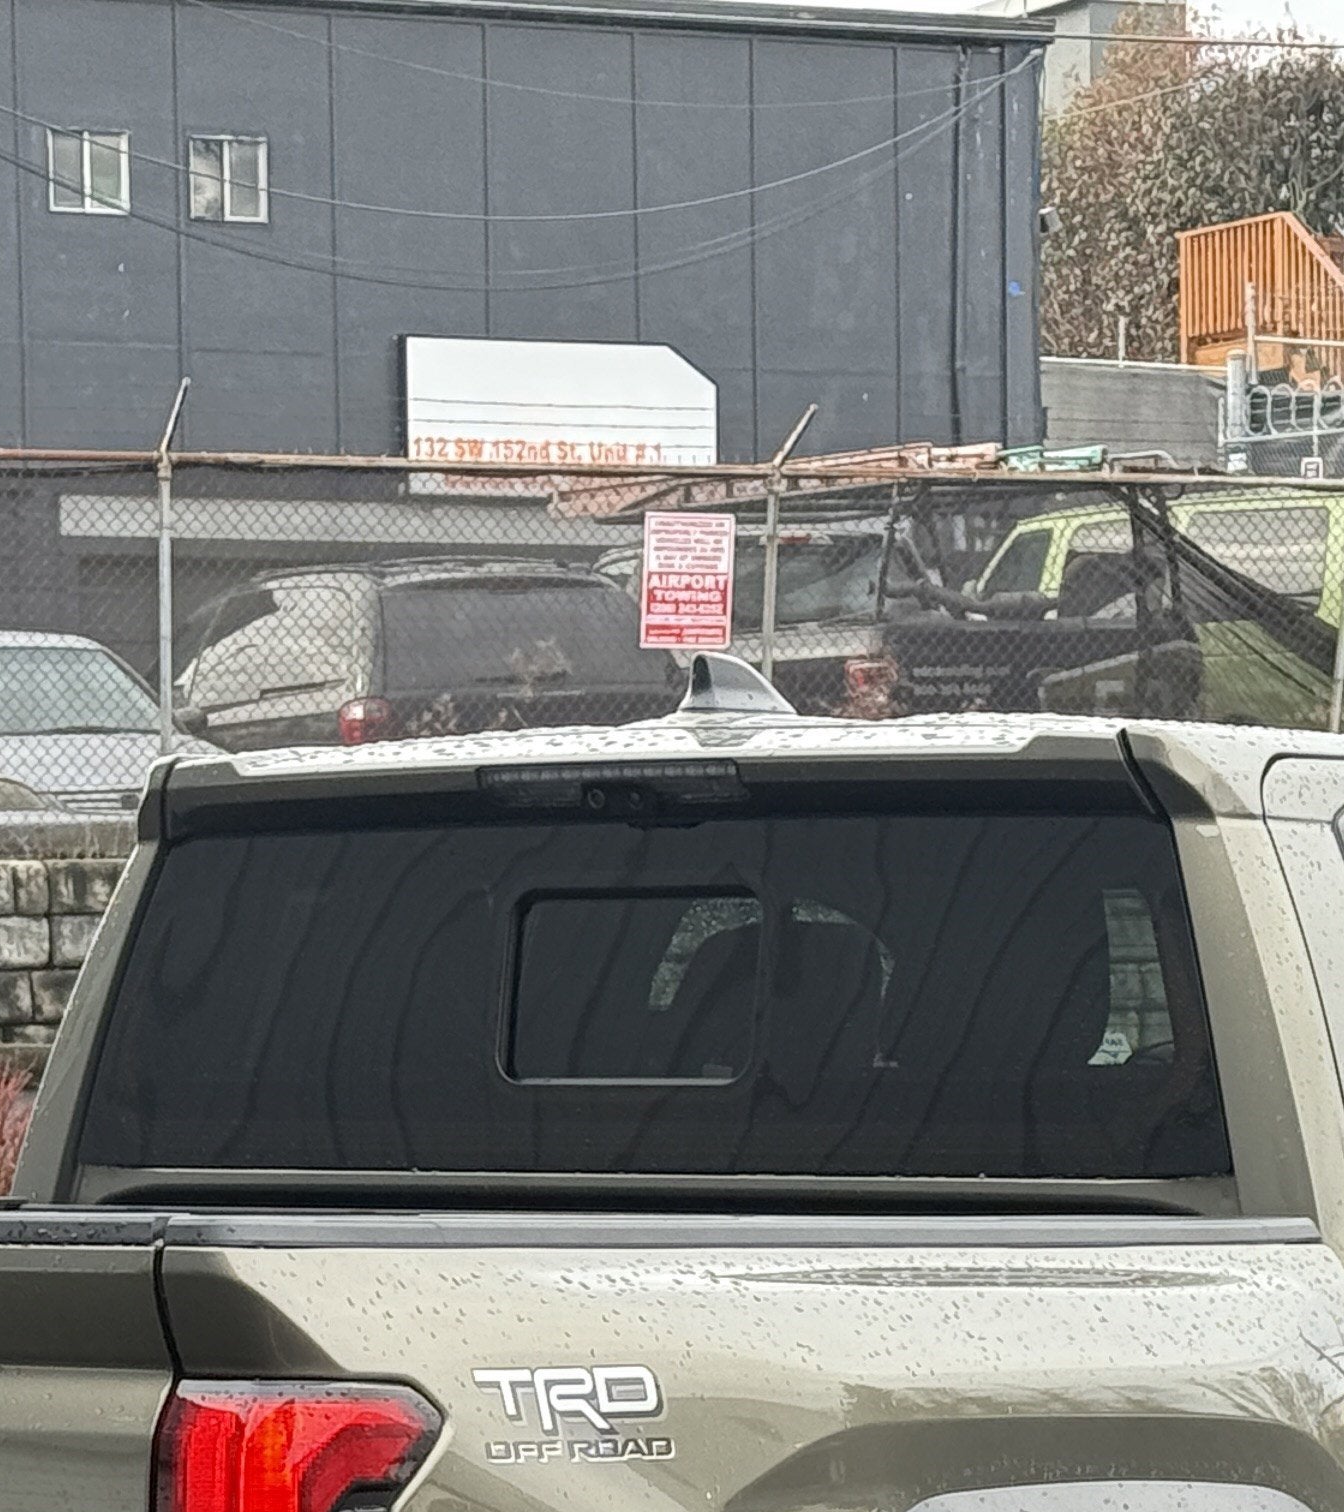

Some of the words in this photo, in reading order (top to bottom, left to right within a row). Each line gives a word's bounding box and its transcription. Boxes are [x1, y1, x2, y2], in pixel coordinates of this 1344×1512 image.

[413, 436, 449, 458] 132
[454, 437, 485, 459] SW
[492, 439, 551, 462] 152nd
[557, 440, 582, 461] St.
[648, 573, 728, 590] AIRPORT
[653, 589, 723, 602] TOWING
[470, 1364, 665, 1436] TRD
[484, 1440, 563, 1464] OFF
[567, 1438, 676, 1463] ROAD
